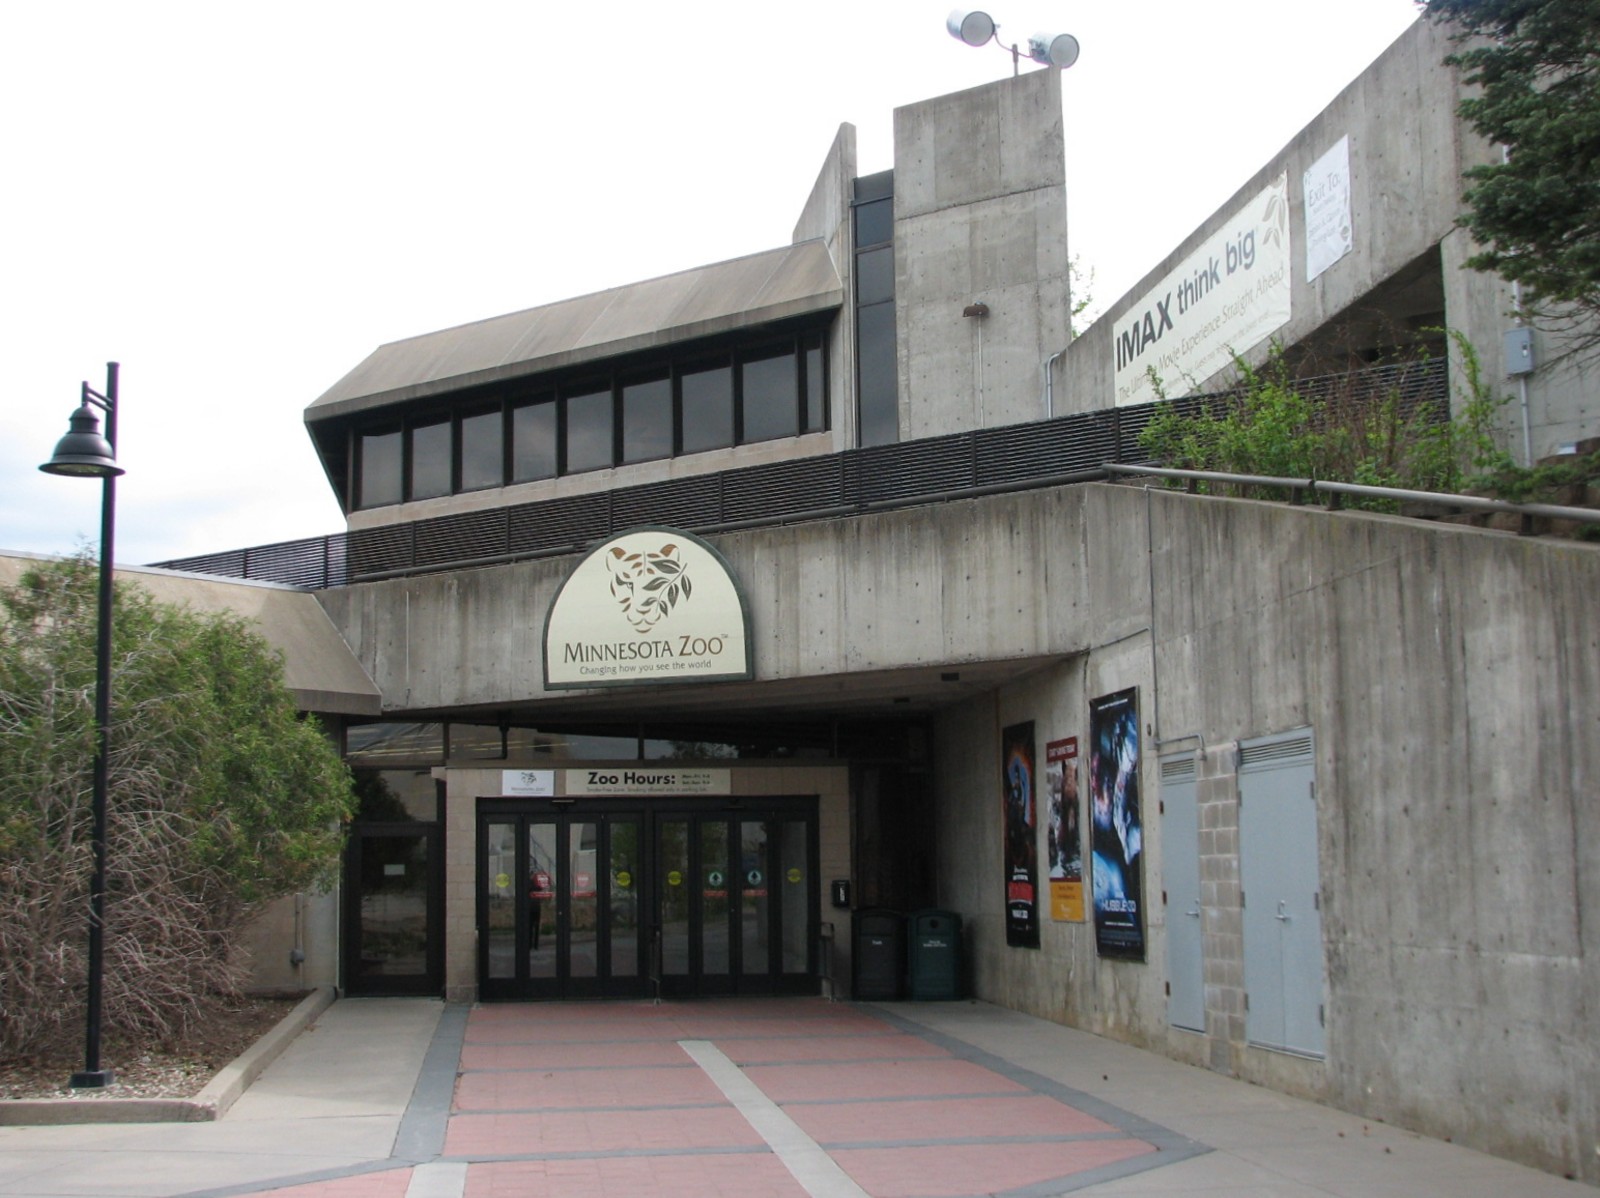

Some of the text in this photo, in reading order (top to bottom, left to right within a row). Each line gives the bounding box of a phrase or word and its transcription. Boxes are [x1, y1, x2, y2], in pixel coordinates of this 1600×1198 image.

[1308, 183, 1325, 208] Exit
[1116, 291, 1174, 373] IMAX
[1177, 256, 1221, 316] think
[1225, 228, 1255, 276] big
[1118, 383, 1130, 403] The
[1158, 344, 1180, 374] Movie
[1181, 313, 1224, 356] Experience
[1222, 286, 1254, 326] Straight
[1256, 262, 1285, 300] Ahead
[564, 634, 723, 663] MINNESOTA ZOO
[579, 659, 712, 676] Changing how you see the world
[588, 771, 619, 785] Zoo
[624, 771, 676, 785] Hours:
